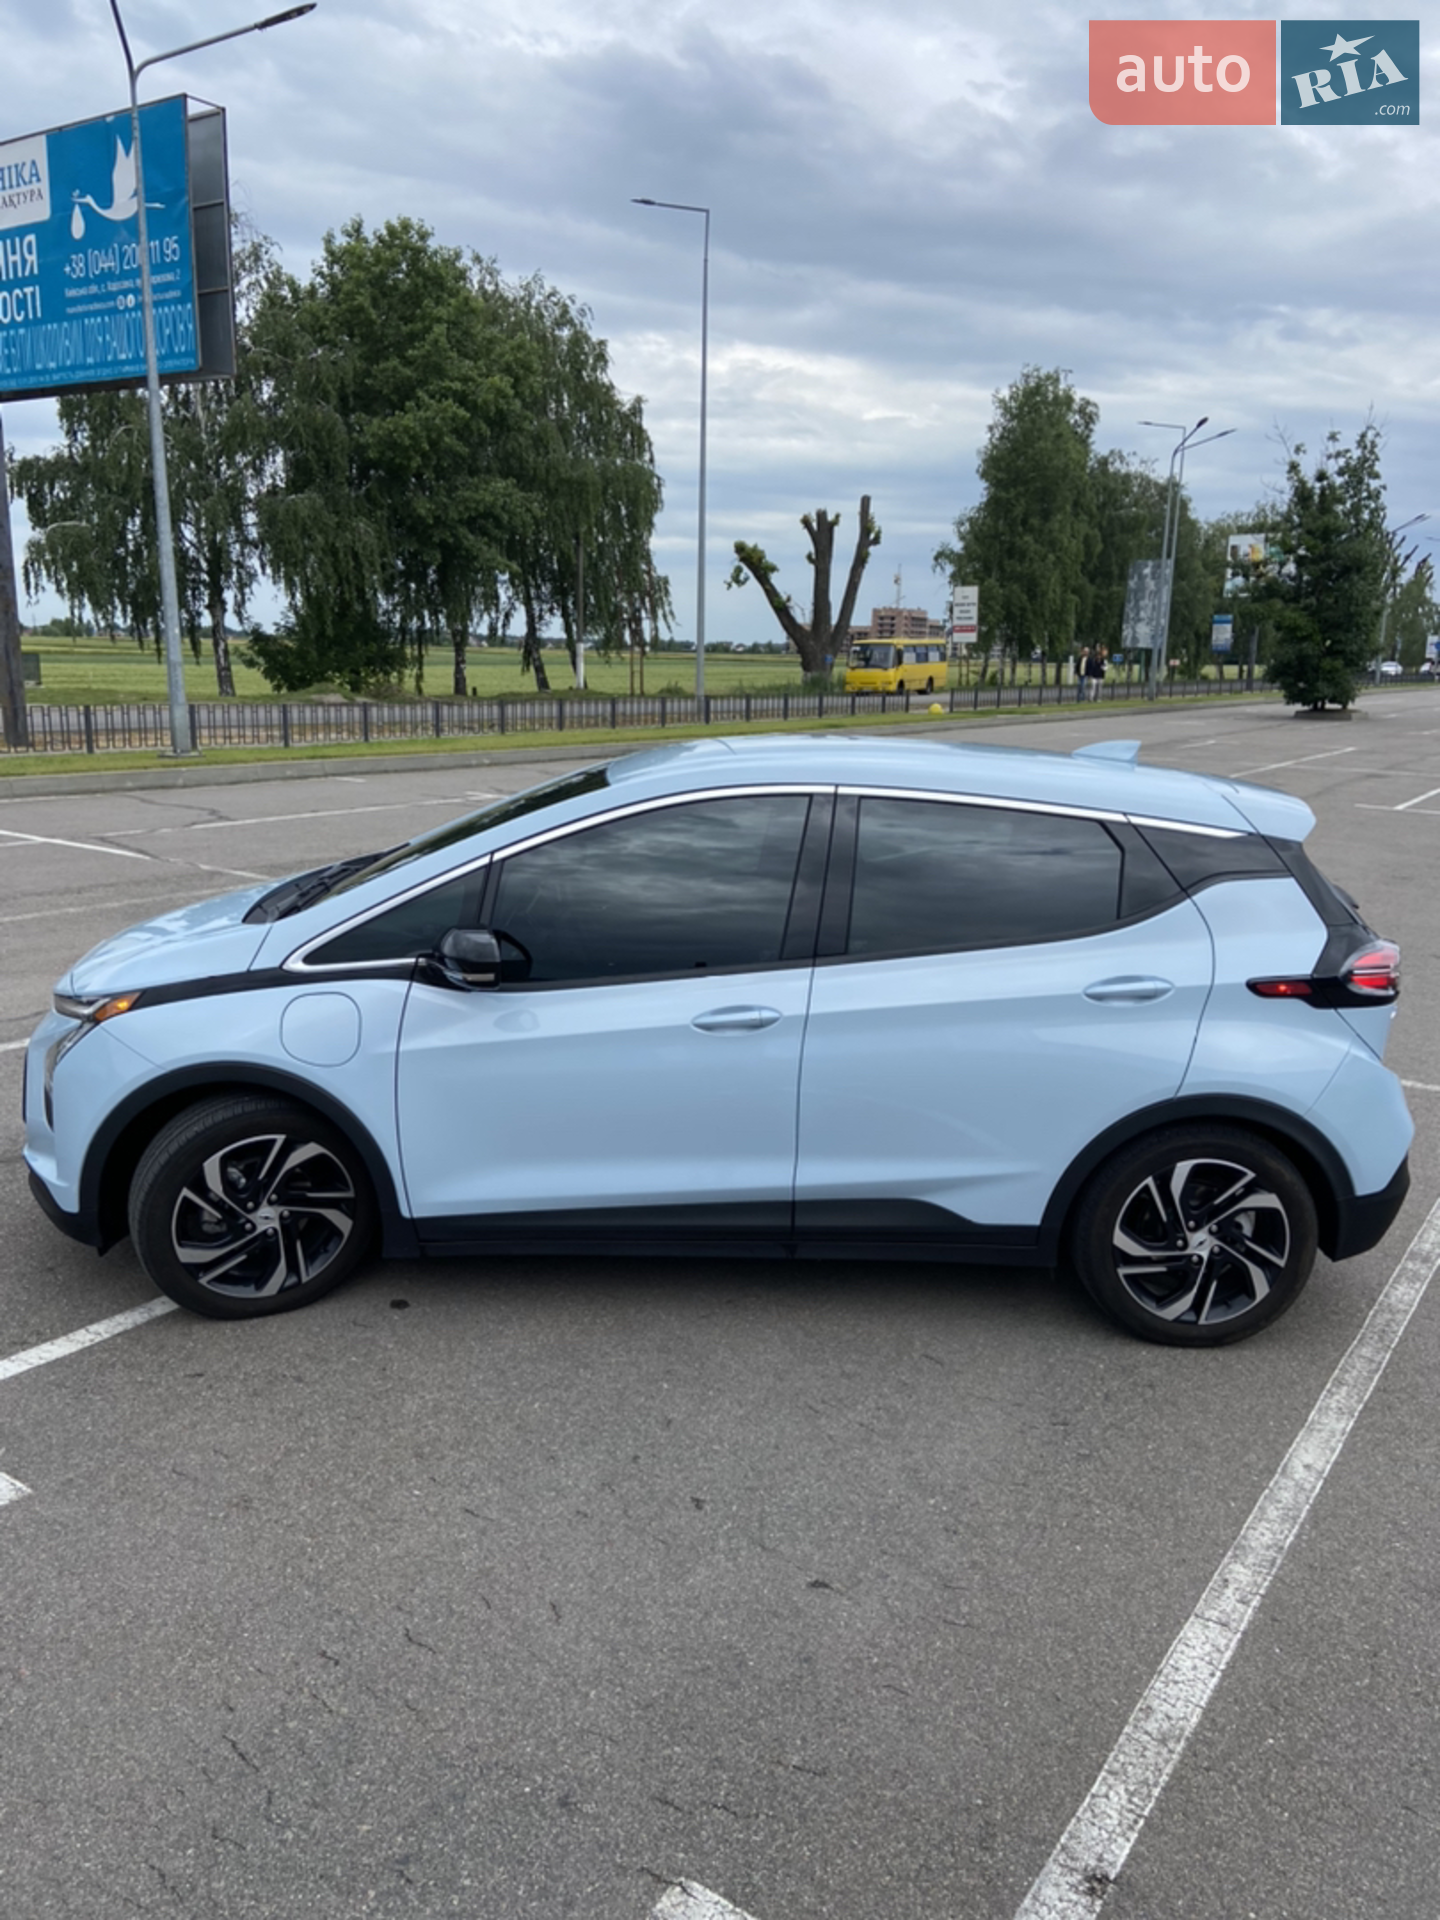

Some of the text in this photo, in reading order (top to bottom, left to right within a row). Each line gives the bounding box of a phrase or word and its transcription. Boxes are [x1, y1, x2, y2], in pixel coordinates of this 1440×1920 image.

[63, 252, 86, 279] +38
[88, 242, 120, 279] (044)
[122, 242, 140, 270] 20
[163, 235, 180, 263] 95
